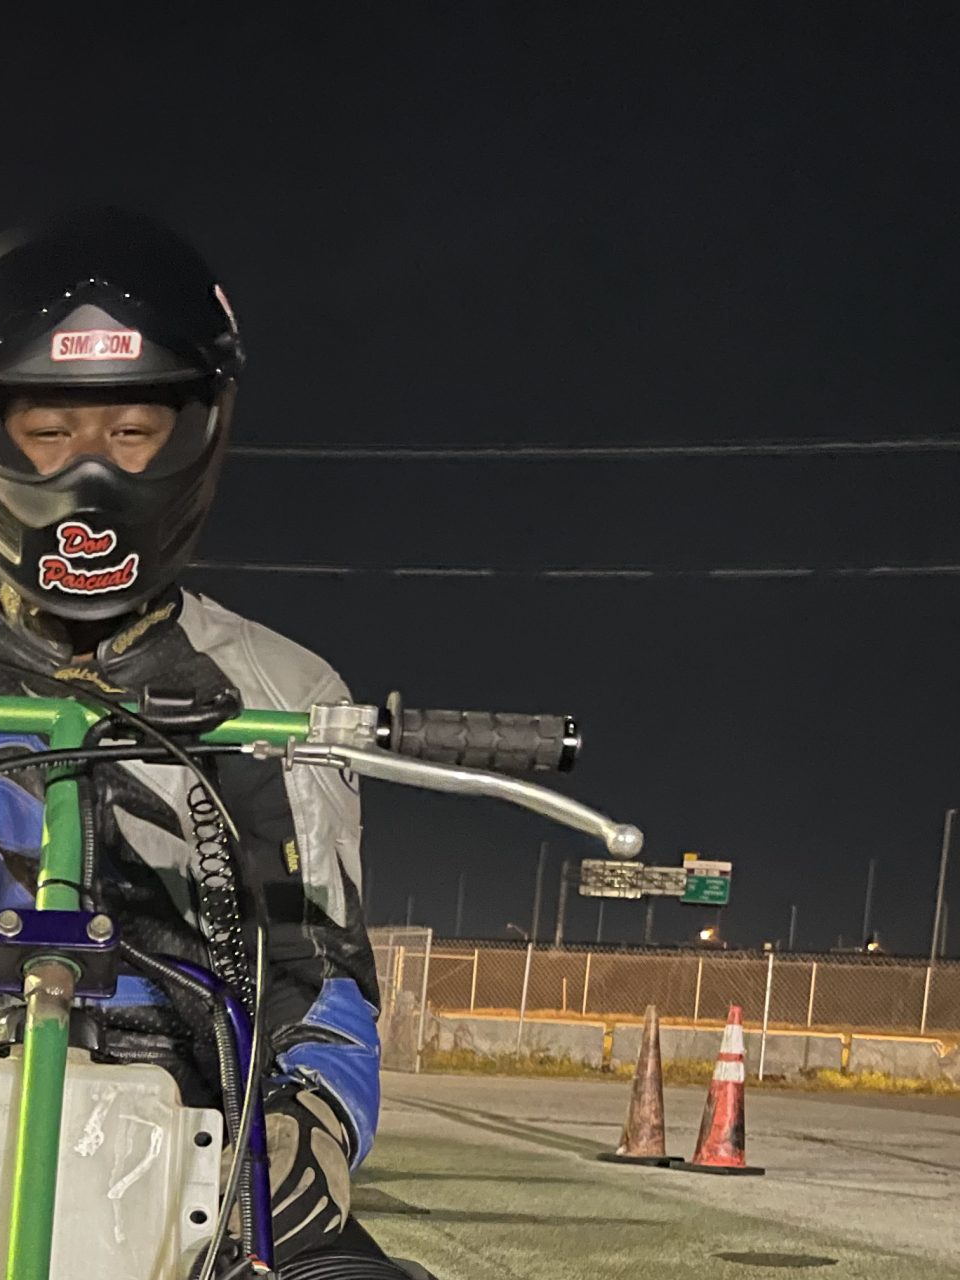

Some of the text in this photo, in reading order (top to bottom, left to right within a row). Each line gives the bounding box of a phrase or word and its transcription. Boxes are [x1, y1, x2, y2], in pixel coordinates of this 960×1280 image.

[59, 334, 132, 356] SIMSON
[60, 524, 113, 554] Don
[41, 558, 135, 590] Pascual
